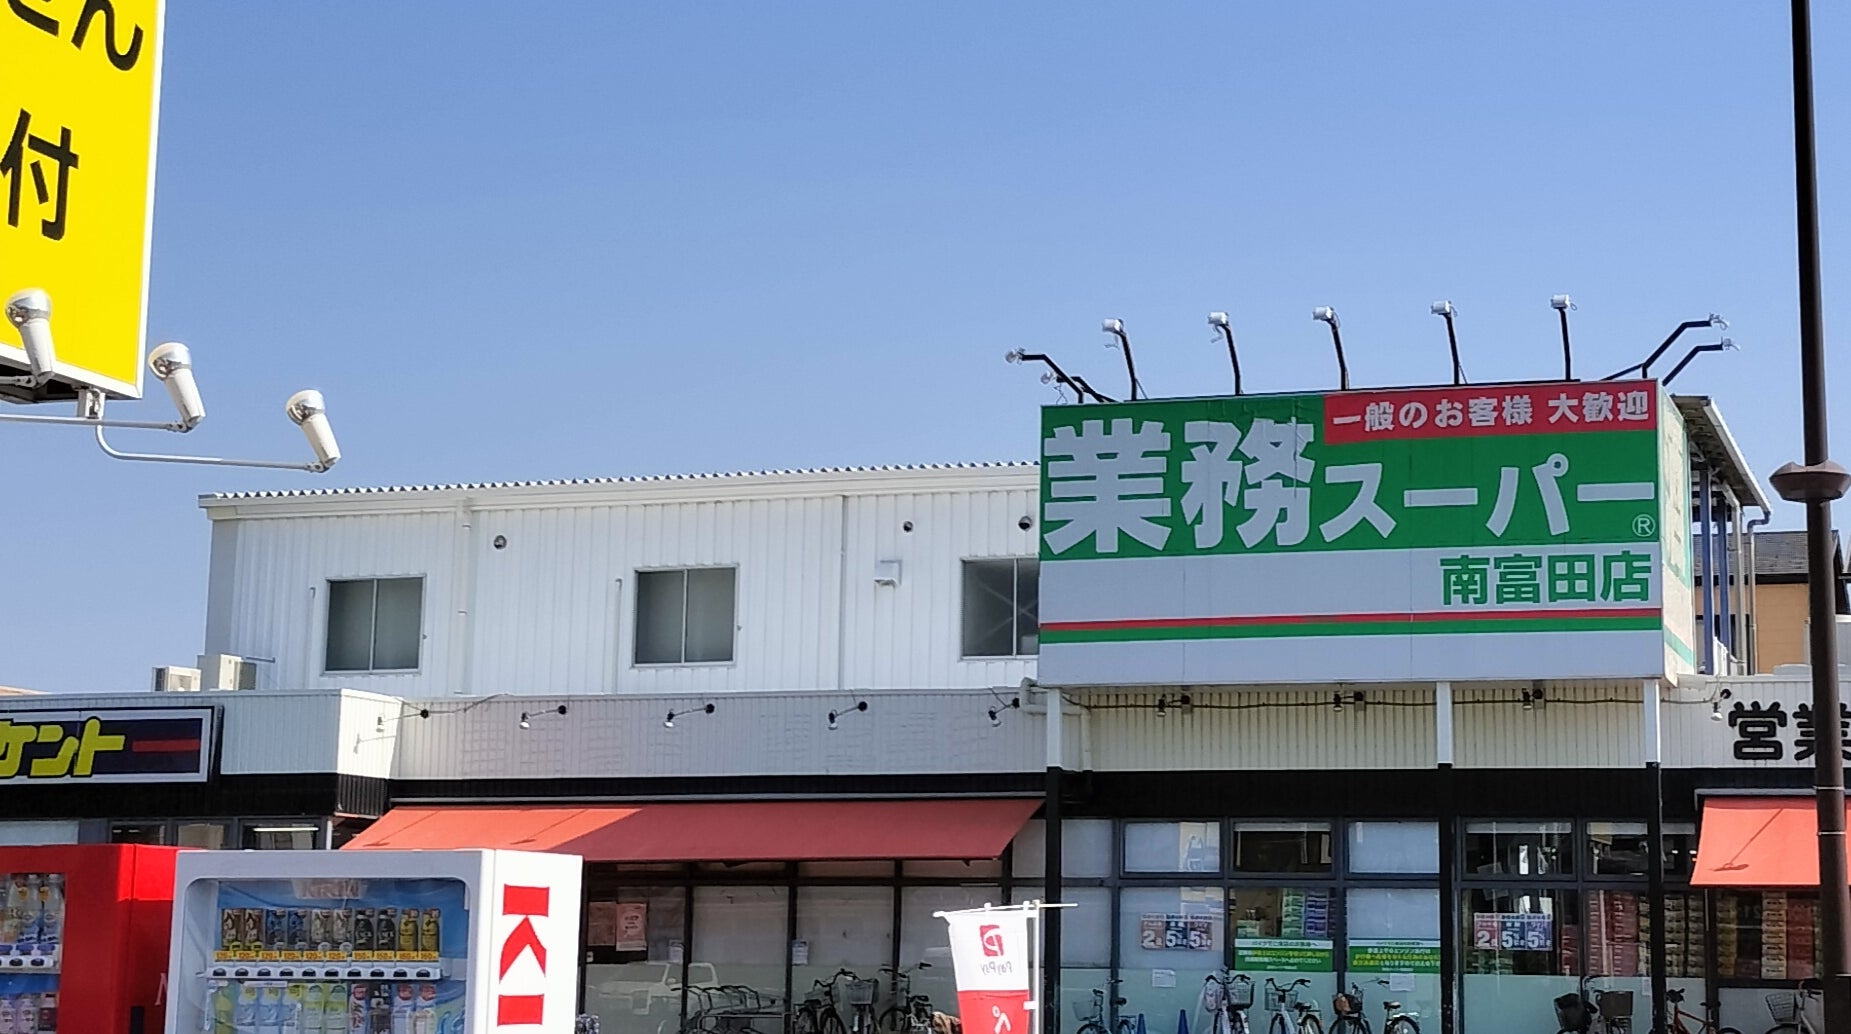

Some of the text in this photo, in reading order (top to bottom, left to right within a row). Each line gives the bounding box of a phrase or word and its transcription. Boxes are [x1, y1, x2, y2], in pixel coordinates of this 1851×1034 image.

[1332, 389, 1650, 432] 一般のお客様 大歓迎
[1043, 416, 1656, 556] 業務スーパー
[1440, 550, 1652, 606] 南富田店
